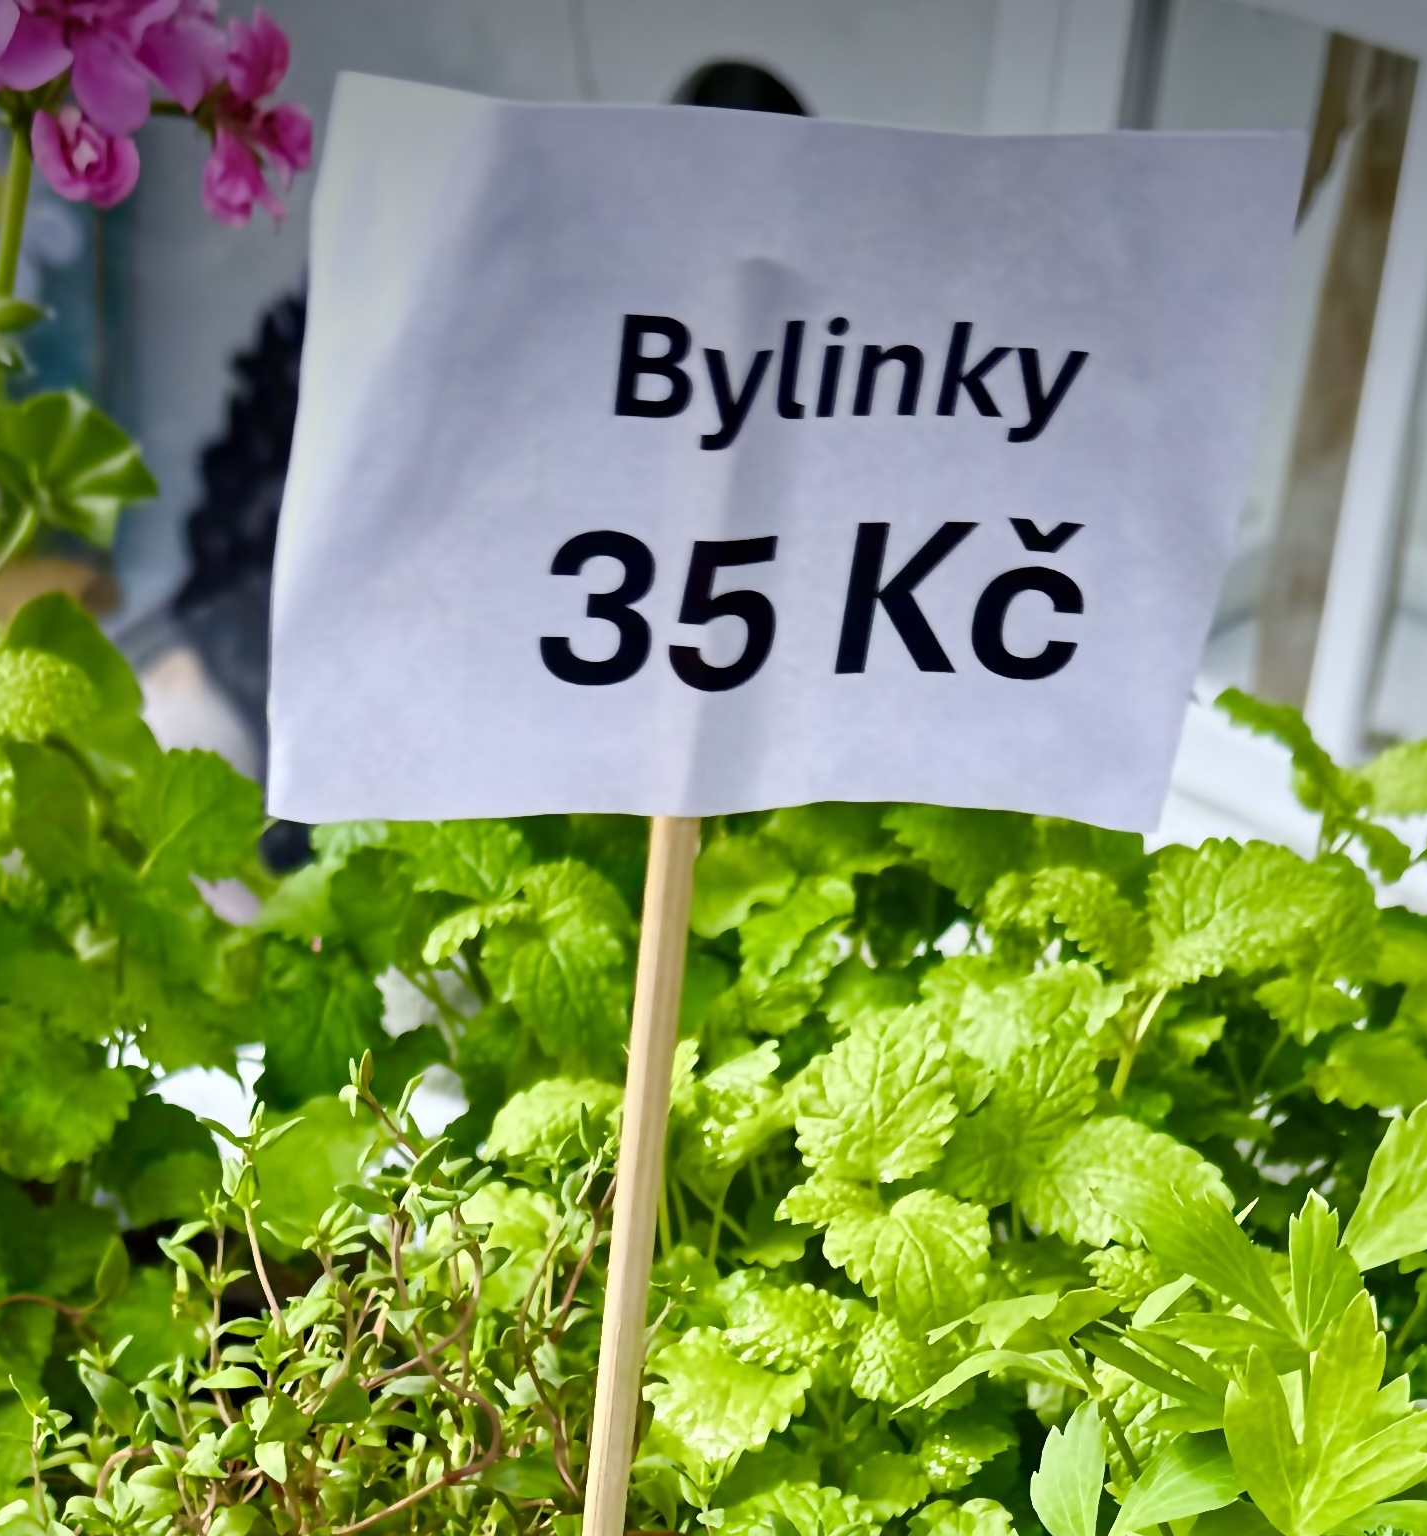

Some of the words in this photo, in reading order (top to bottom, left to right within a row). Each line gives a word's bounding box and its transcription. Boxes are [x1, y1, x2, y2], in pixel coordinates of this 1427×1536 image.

[612, 313, 1091, 452] Bylinky
[539, 529, 779, 693] 35
[834, 517, 1086, 681] Kč
